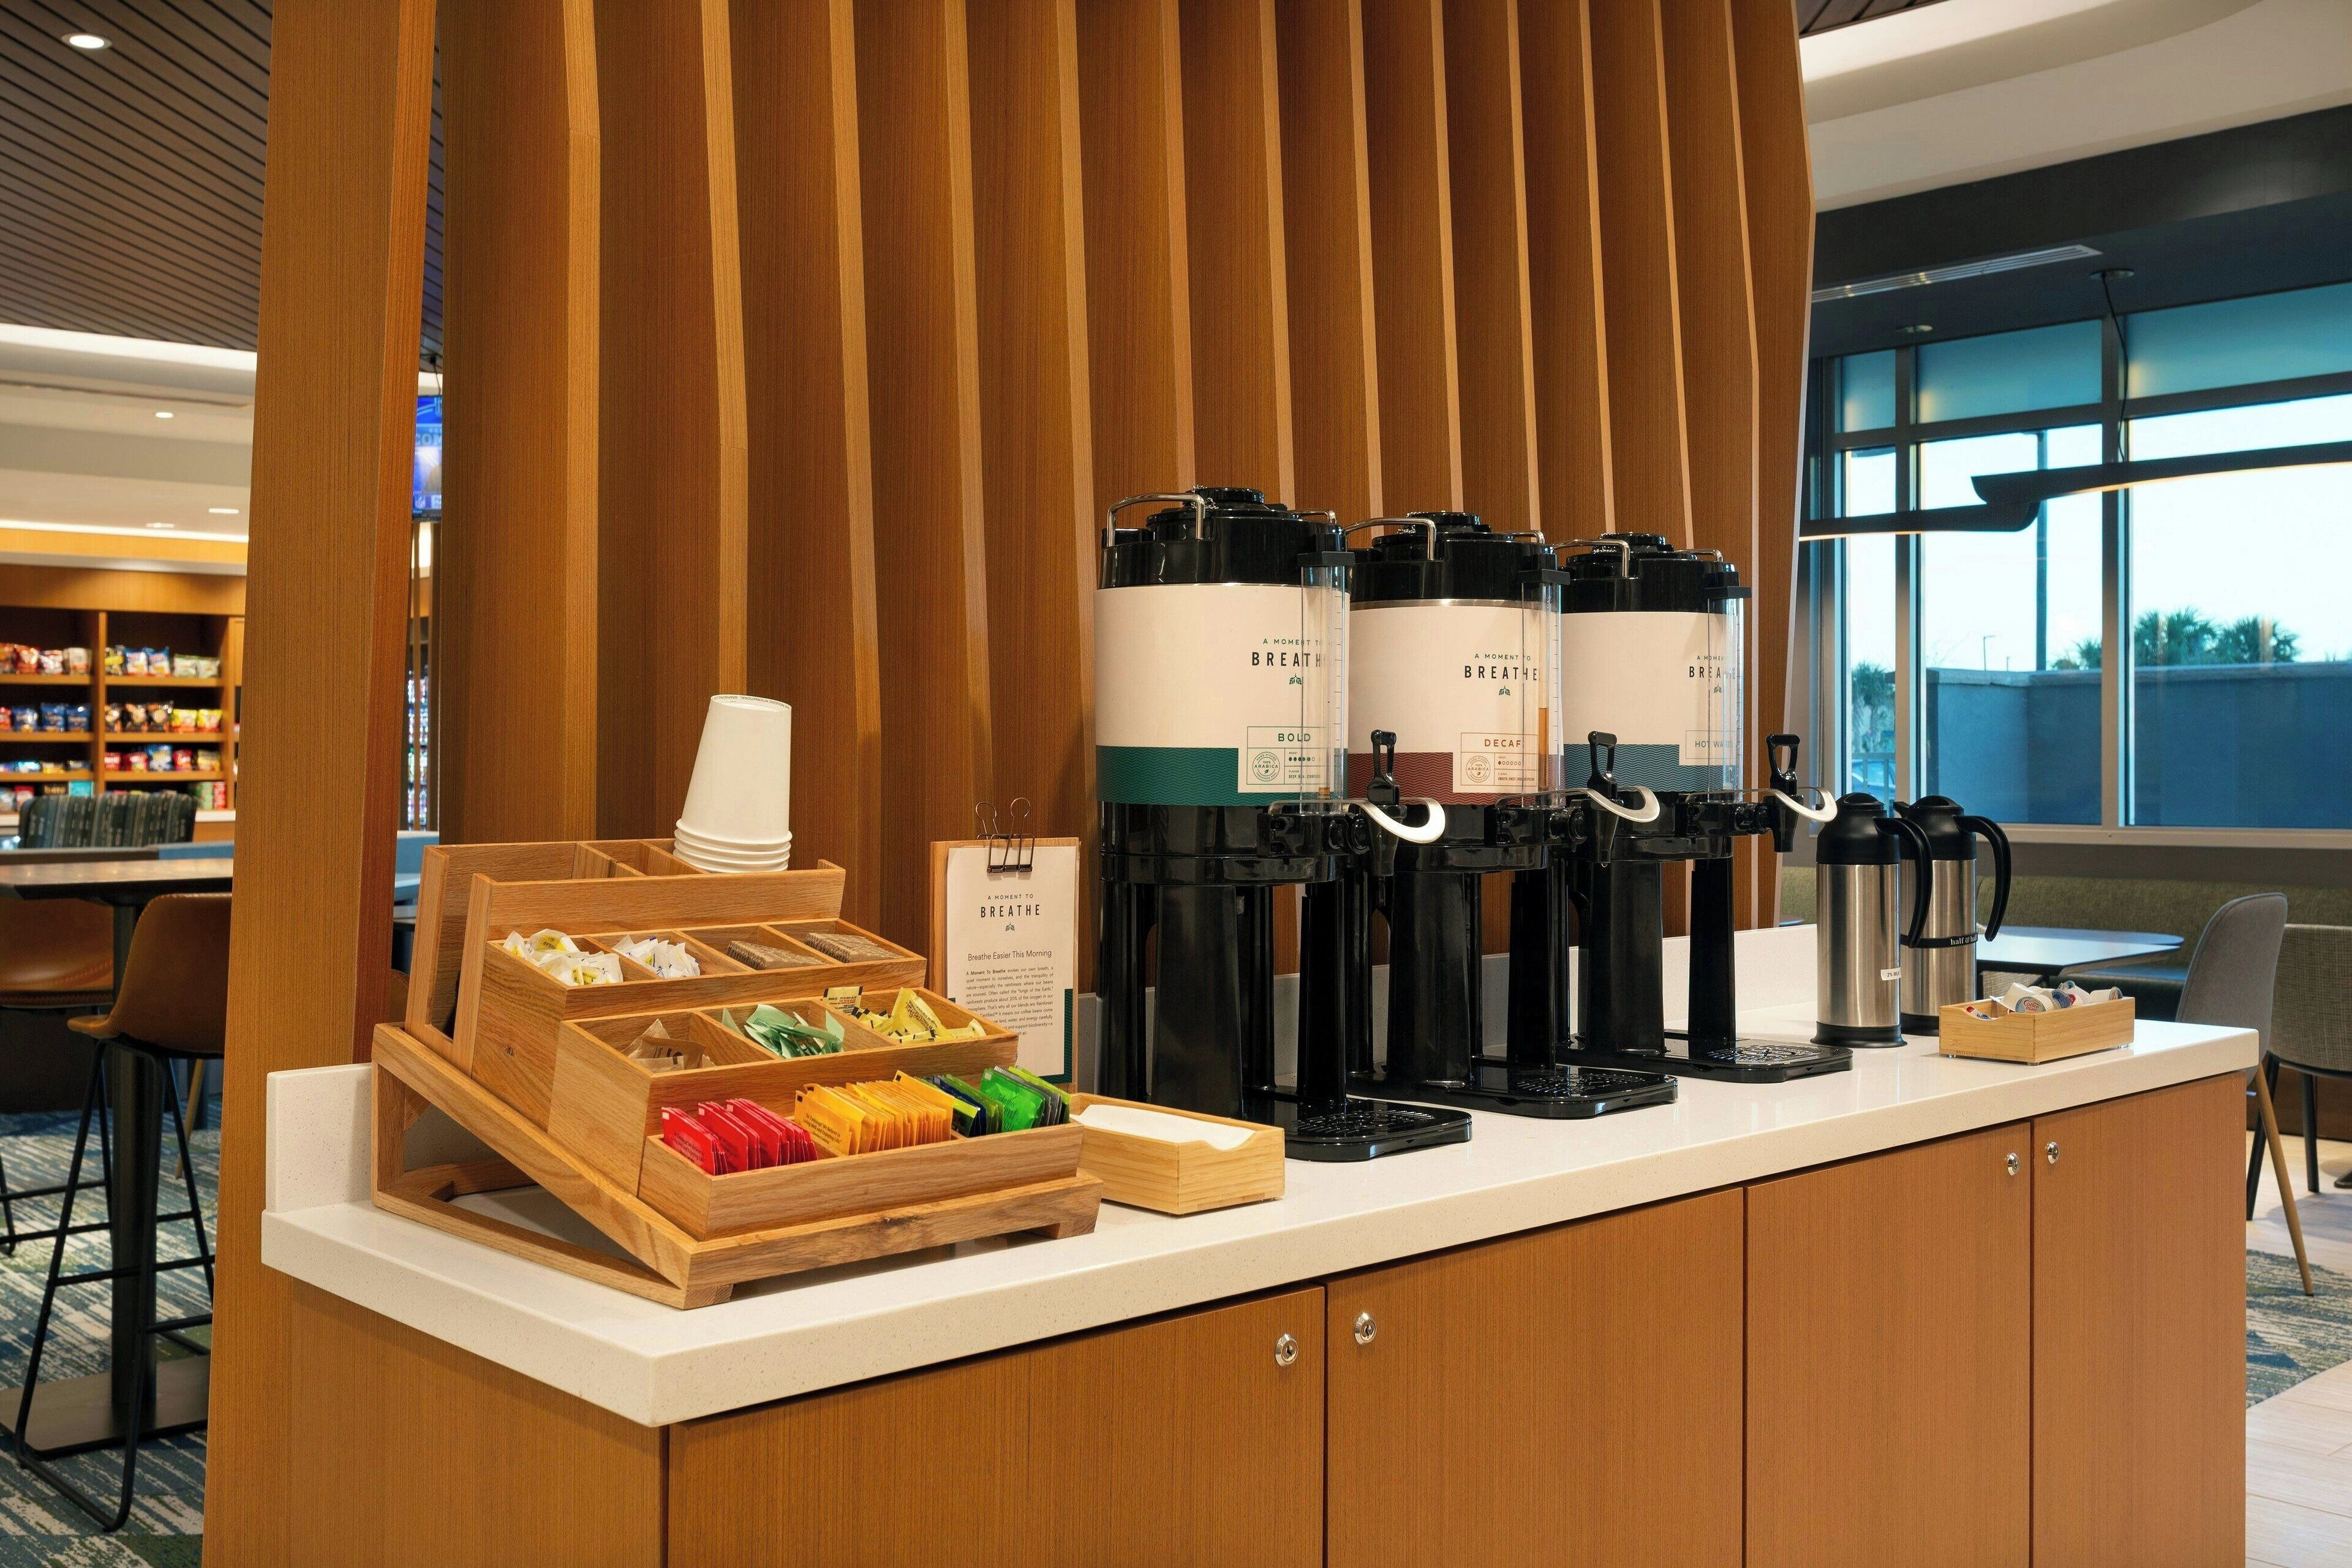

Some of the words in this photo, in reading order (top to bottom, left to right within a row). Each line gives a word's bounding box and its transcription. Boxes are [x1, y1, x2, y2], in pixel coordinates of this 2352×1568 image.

[1252, 652, 1324, 667] BREATH
[1464, 665, 1537, 680] BREATHE
[1278, 733, 1311, 742] BOLD
[981, 904, 1040, 918] BREATHE
[1950, 937, 1964, 946] half
[1026, 949, 1052, 958] Morning
[2024, 1000, 2040, 1009] Coffee
